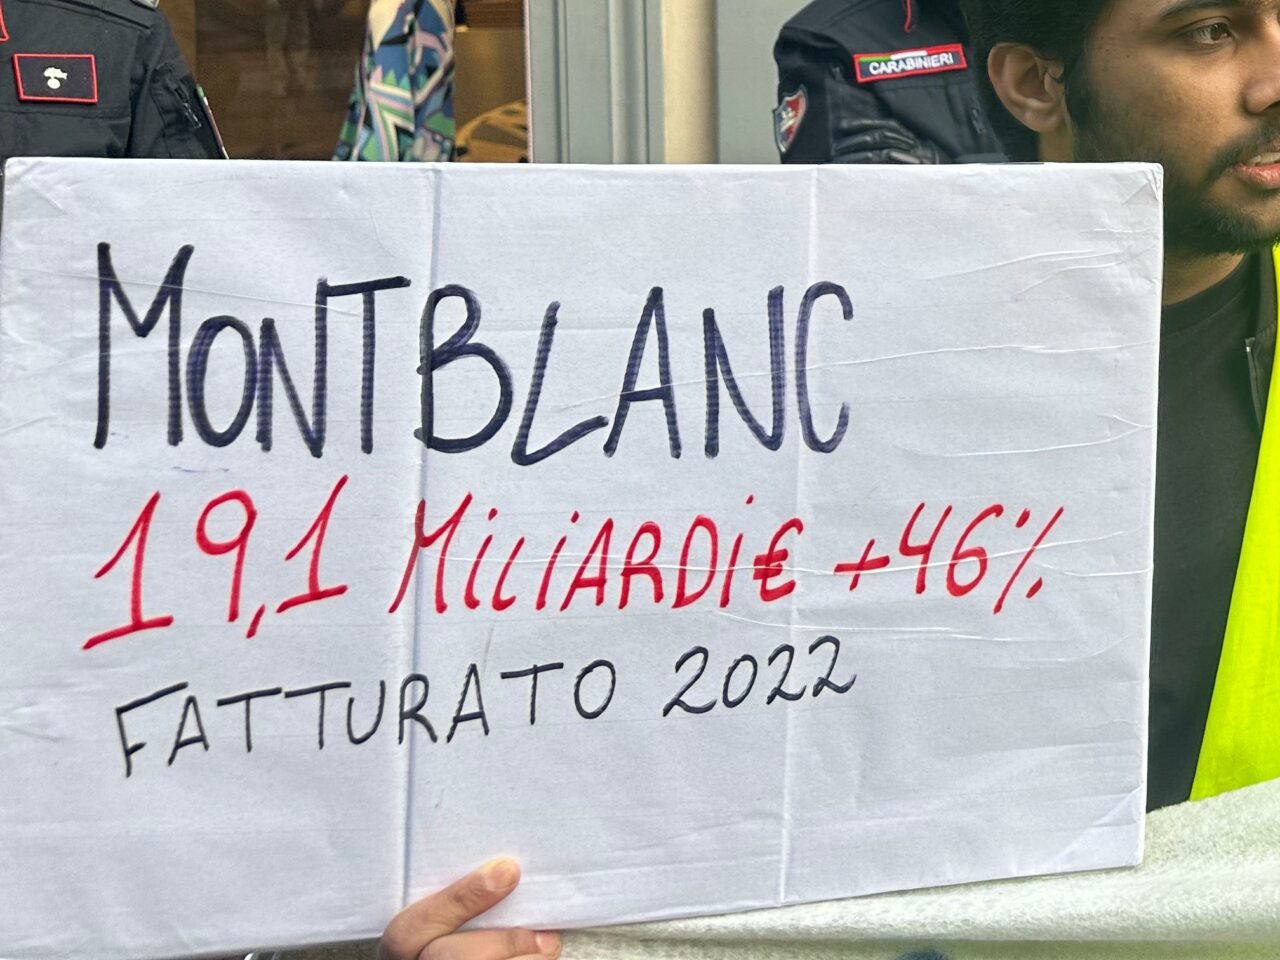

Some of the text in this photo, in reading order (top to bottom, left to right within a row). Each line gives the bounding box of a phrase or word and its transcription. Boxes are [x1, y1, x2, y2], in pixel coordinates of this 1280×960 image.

[868, 52, 955, 75] CARABINIERI
[83, 476, 349, 651] 19,1
[833, 503, 1066, 614] +46%
[115, 635, 857, 778] FATTURATO 2022
